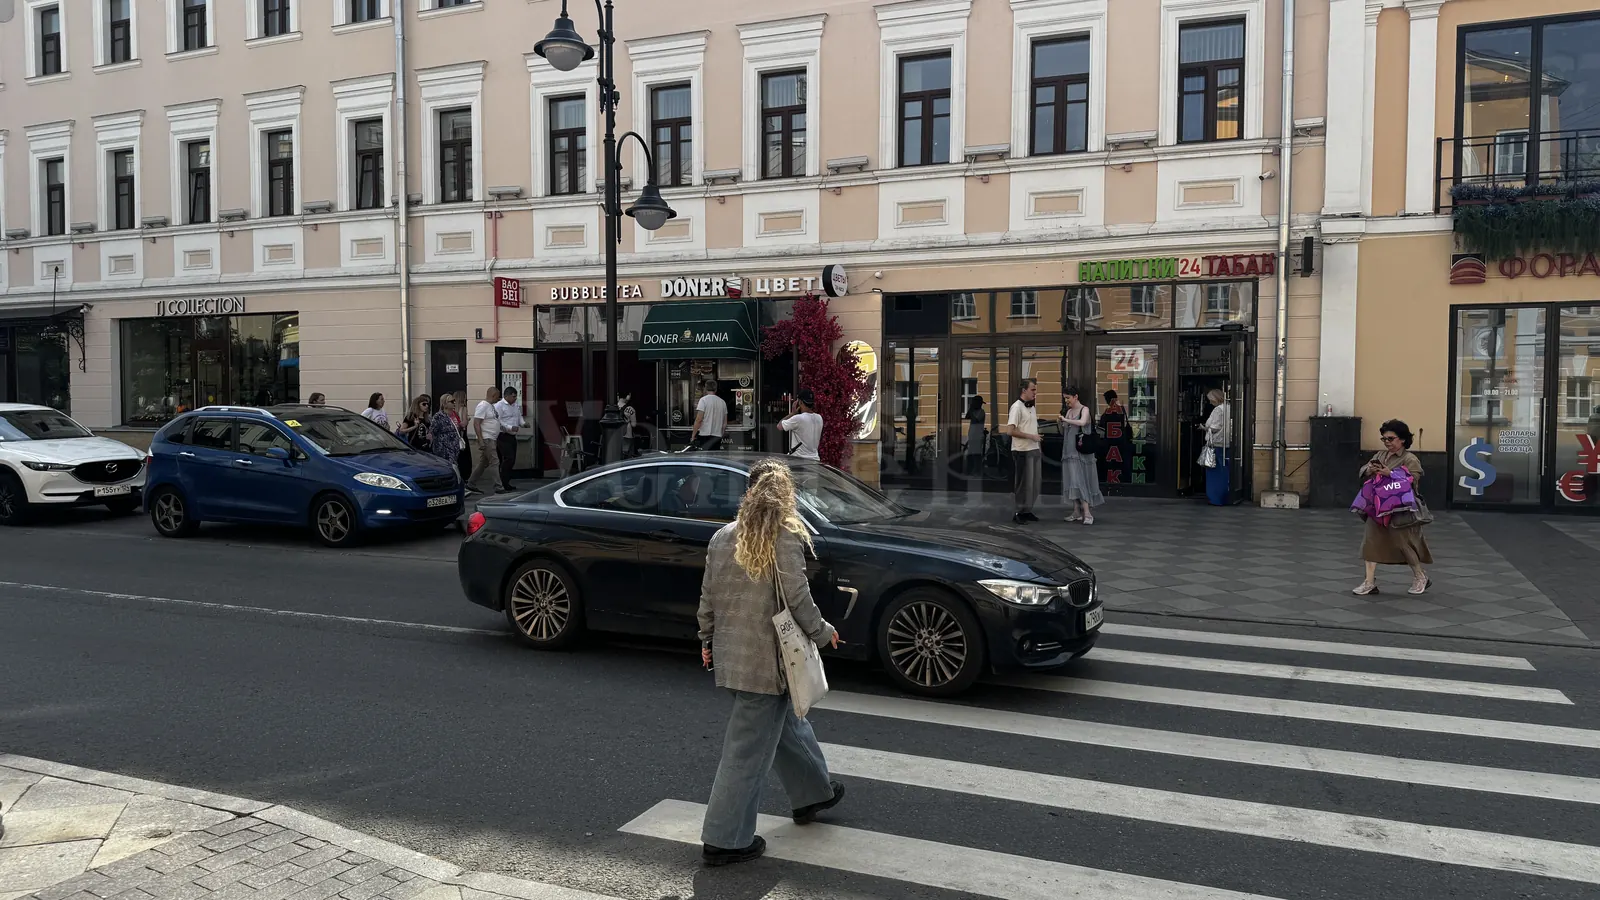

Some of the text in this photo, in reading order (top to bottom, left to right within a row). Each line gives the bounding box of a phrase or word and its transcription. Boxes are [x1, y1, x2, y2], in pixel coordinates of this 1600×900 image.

[1078, 253, 1276, 282] НАПИТКИ 24 ТАБАК
[502, 280, 518, 290] BAO
[551, 286, 606, 300] BUBBLE
[660, 276, 726, 298] DÖNER
[502, 289, 518, 301] BEI
[155, 296, 246, 316] TJ COLLECTION
[644, 332, 729, 344] DONER MANIA
[1115, 350, 1140, 370] 24
[1106, 374, 1123, 484] ТАБАК
[1383, 482, 1401, 491] WB
